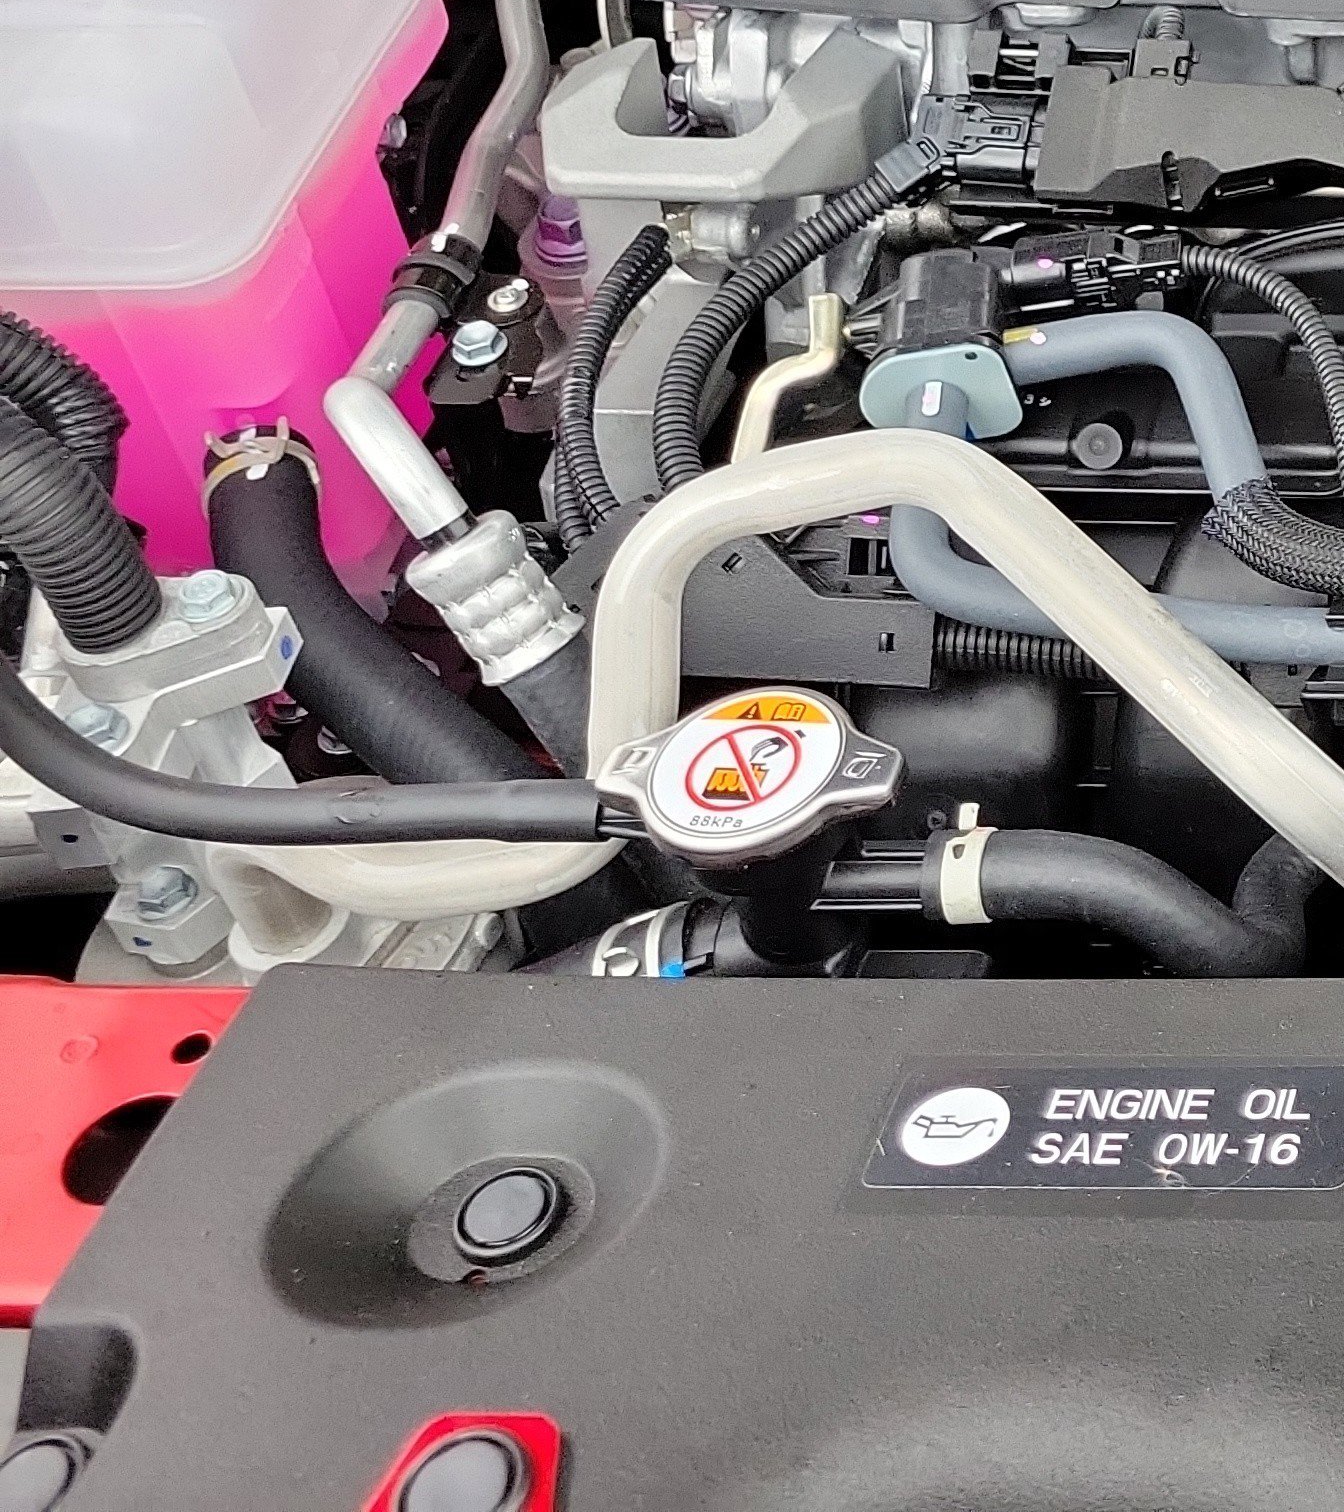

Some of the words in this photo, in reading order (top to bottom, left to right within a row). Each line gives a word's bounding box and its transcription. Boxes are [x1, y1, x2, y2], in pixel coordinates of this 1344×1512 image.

[690, 814, 743, 829] 88kPa
[1045, 1088, 1215, 1120] ENGINE
[1243, 1088, 1311, 1120] OIL
[1030, 1132, 1129, 1165] SAE
[1157, 1132, 1301, 1165] 0W-16
